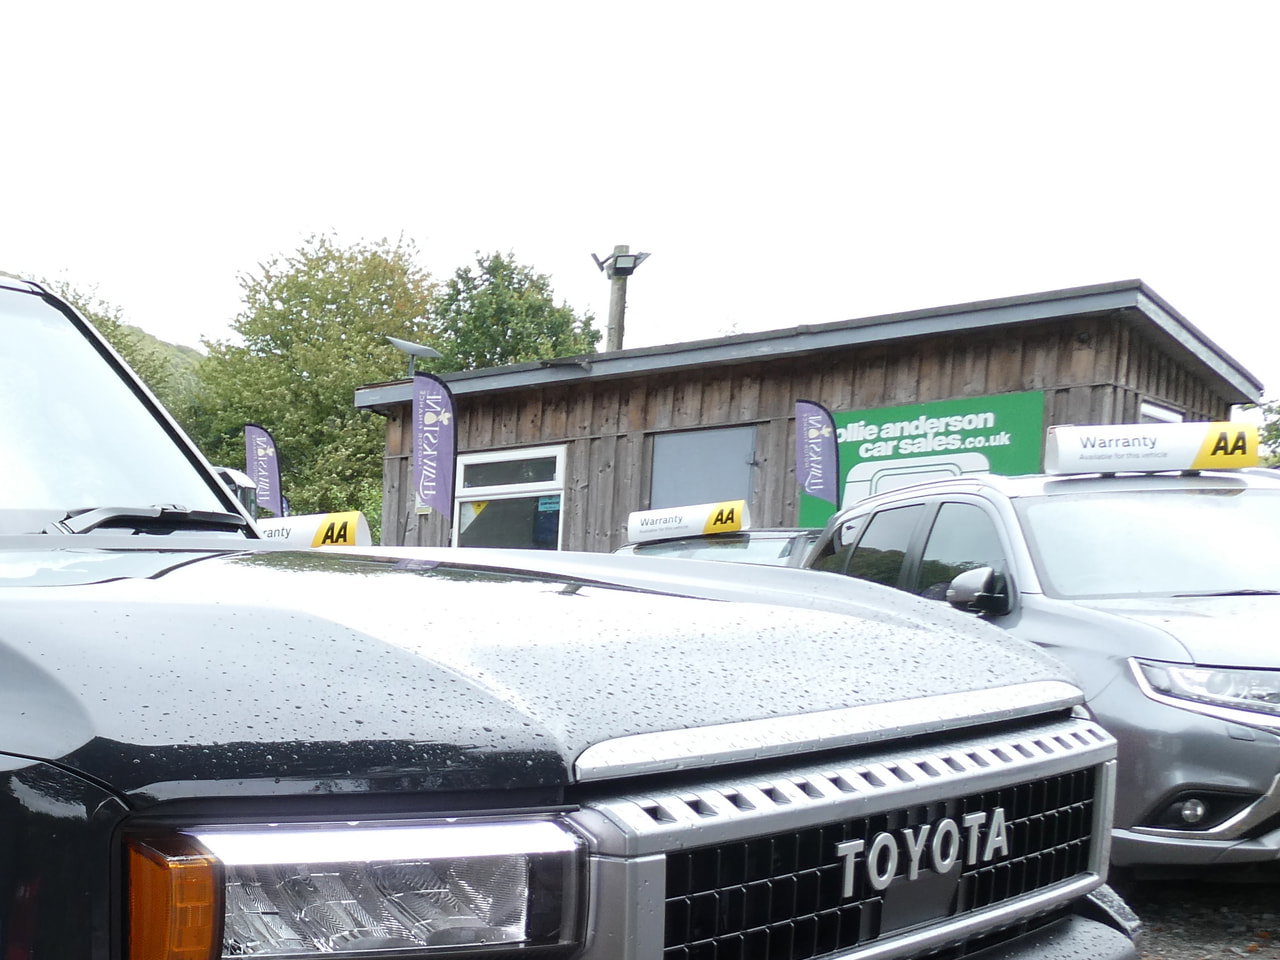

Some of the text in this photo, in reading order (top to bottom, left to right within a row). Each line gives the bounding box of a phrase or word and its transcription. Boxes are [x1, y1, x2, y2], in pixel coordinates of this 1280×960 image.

[836, 412, 995, 443] ollie anderson
[859, 431, 1012, 458] car sales.co.uk
[1080, 435, 1158, 450] Warranty
[1210, 431, 1247, 456] AA
[640, 515, 683, 527] Warranty
[712, 507, 736, 526] AA
[263, 527, 292, 540] ranty
[320, 520, 349, 545] AA
[836, 807, 1009, 898] TOYOTA
